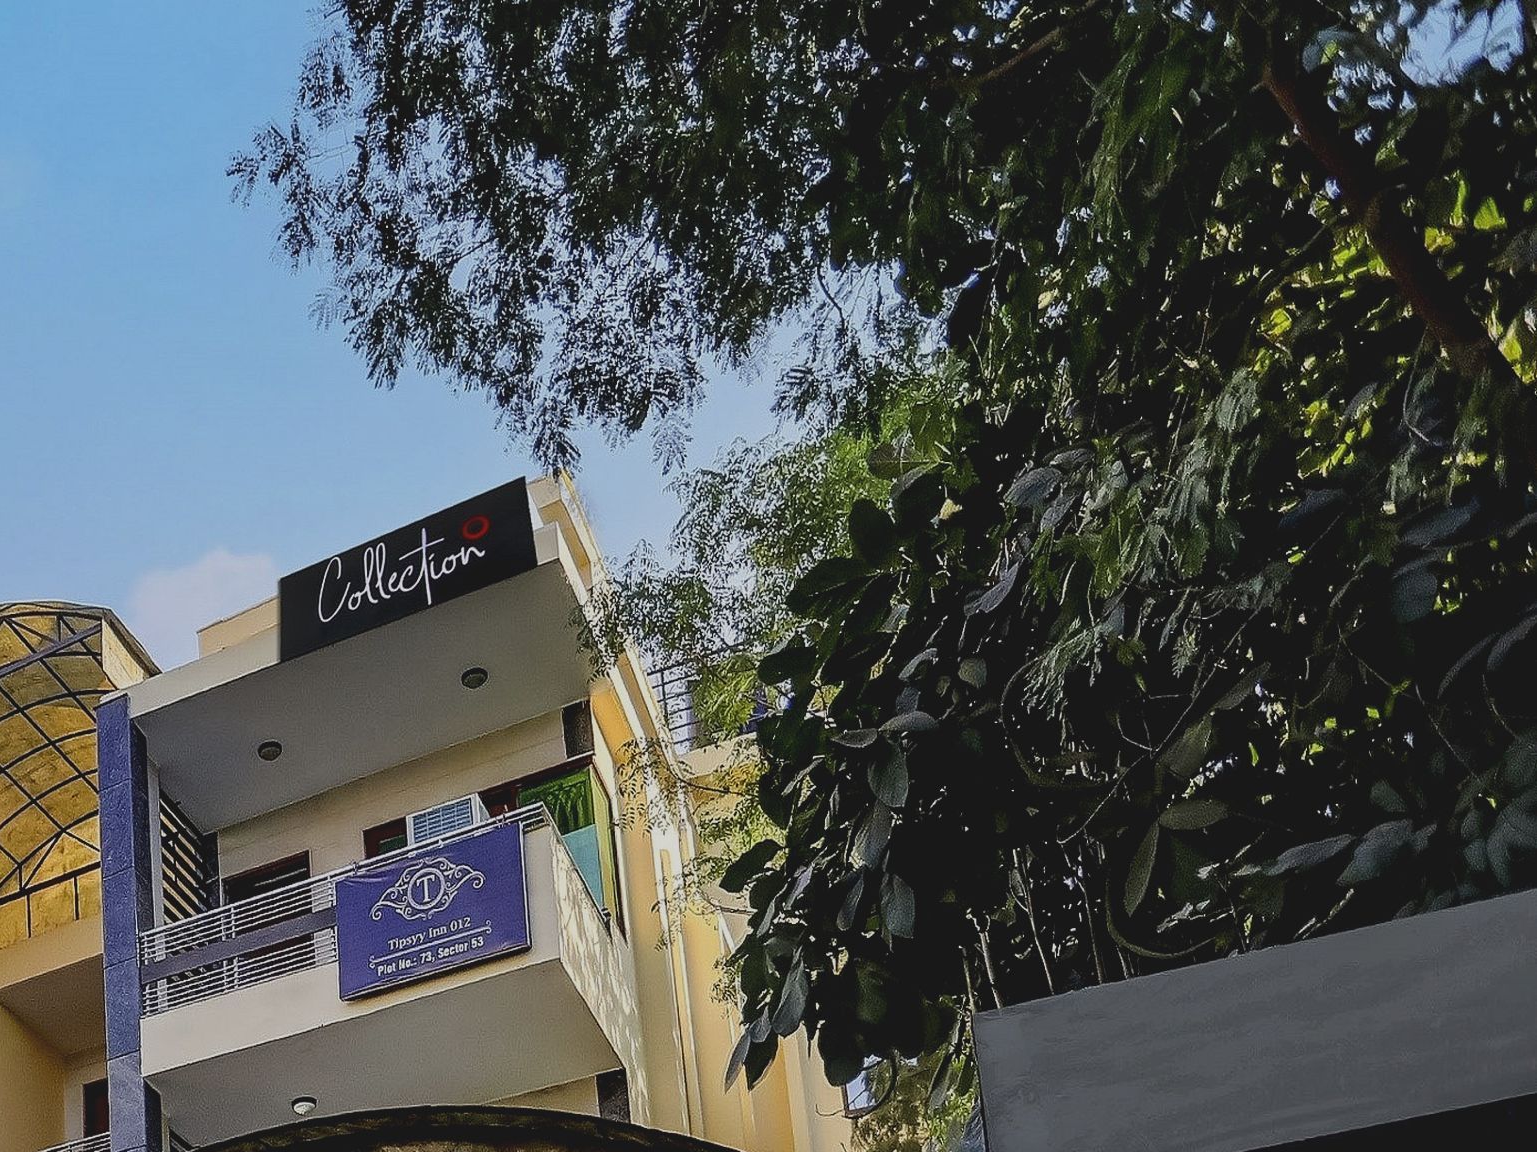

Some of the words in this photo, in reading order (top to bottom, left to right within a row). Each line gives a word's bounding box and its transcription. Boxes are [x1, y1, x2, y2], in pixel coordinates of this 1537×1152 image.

[317, 527, 486, 624] Collection
[416, 874, 435, 903] T
[388, 932, 426, 950] Tipsyy
[429, 926, 447, 938] Inn
[450, 918, 471, 932] 012
[377, 963, 396, 977] Plot
[419, 951, 436, 964] 73,
[437, 942, 469, 959] Sector
[471, 936, 484, 949] 53
